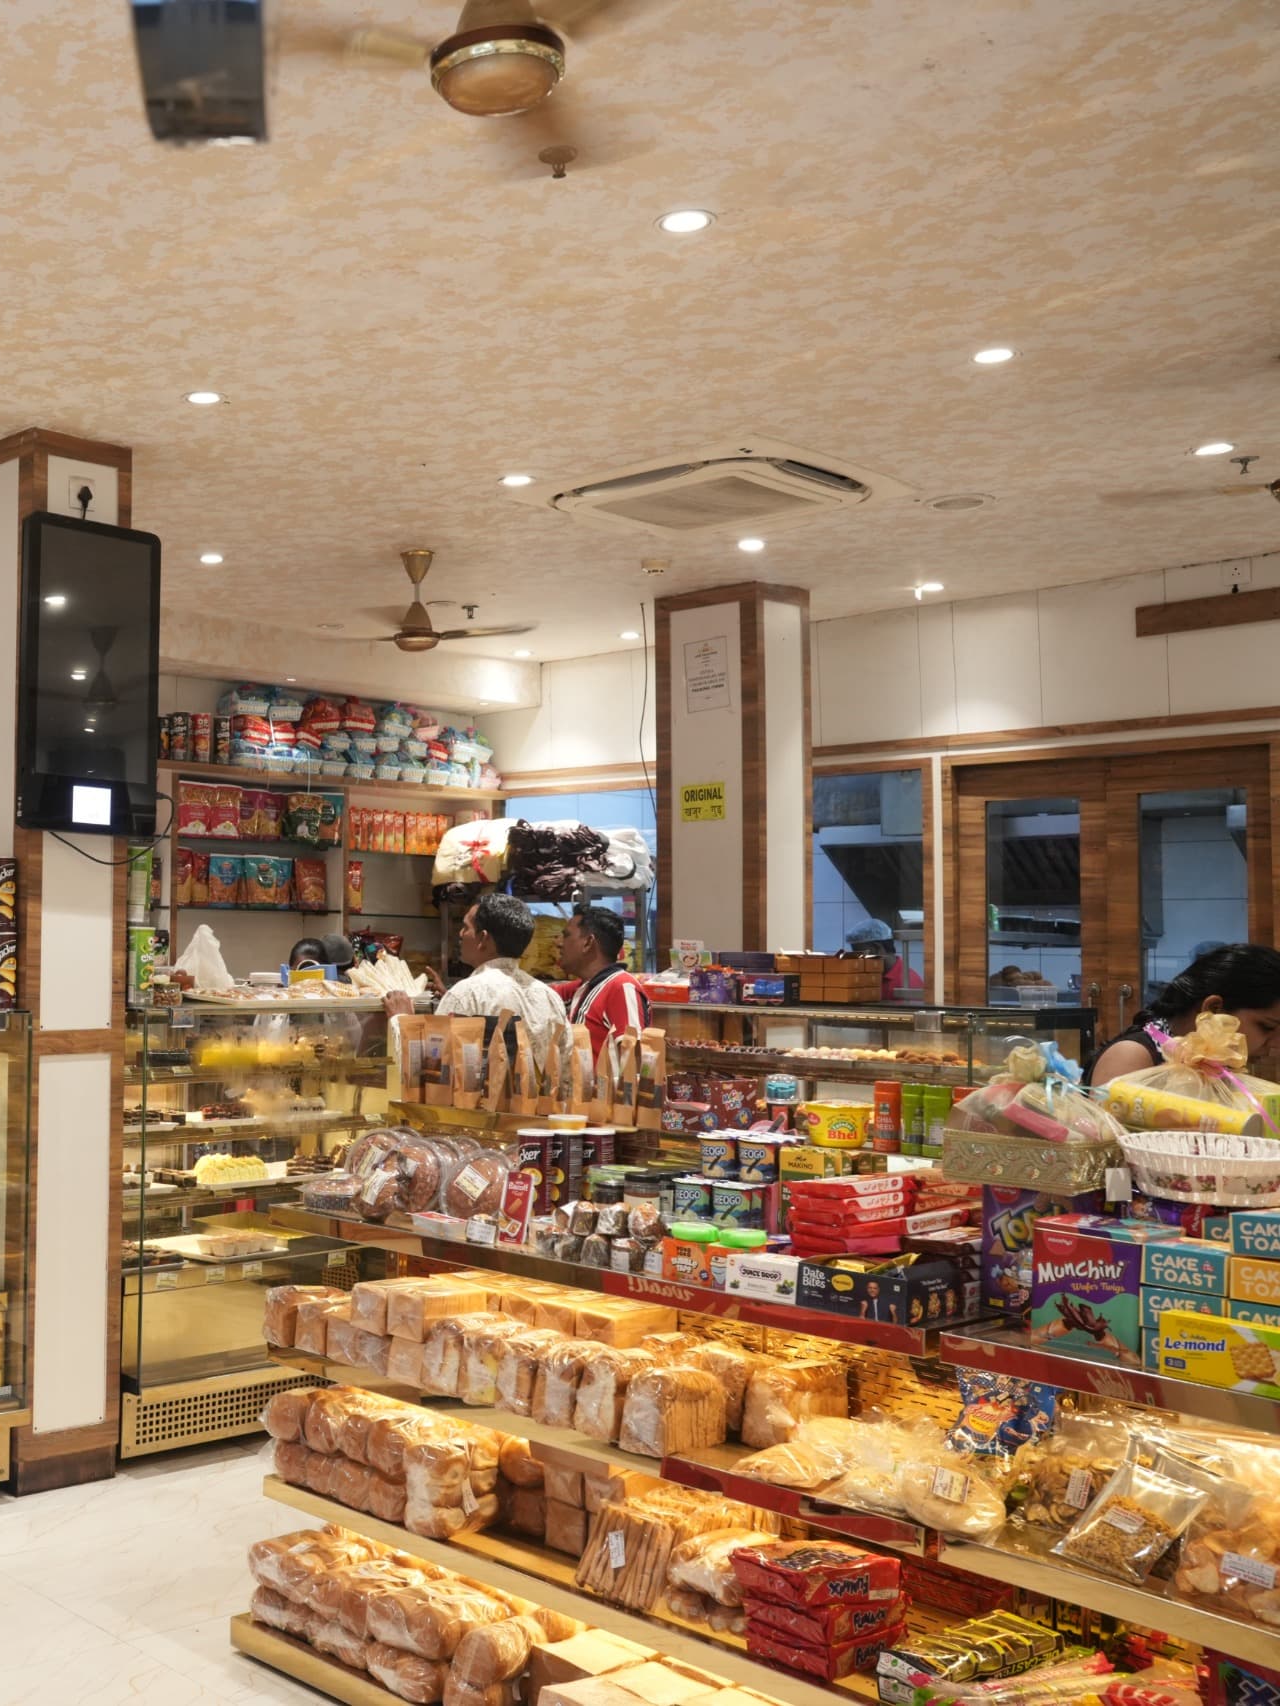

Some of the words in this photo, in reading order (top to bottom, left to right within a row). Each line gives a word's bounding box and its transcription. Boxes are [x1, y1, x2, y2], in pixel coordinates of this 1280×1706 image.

[684, 787, 724, 802] ORIGINAL
[828, 1130, 857, 1139] Bhel
[1240, 1236, 1280, 1252] TOA
[1151, 1252, 1199, 1272] CAKE
[802, 1266, 826, 1280] Date
[1037, 1259, 1125, 1284] Munchini
[1151, 1266, 1217, 1289] TOAST
[802, 1277, 826, 1290] Bites
[1240, 1280, 1280, 1298] TOA
[1149, 1295, 1197, 1312] CAKE
